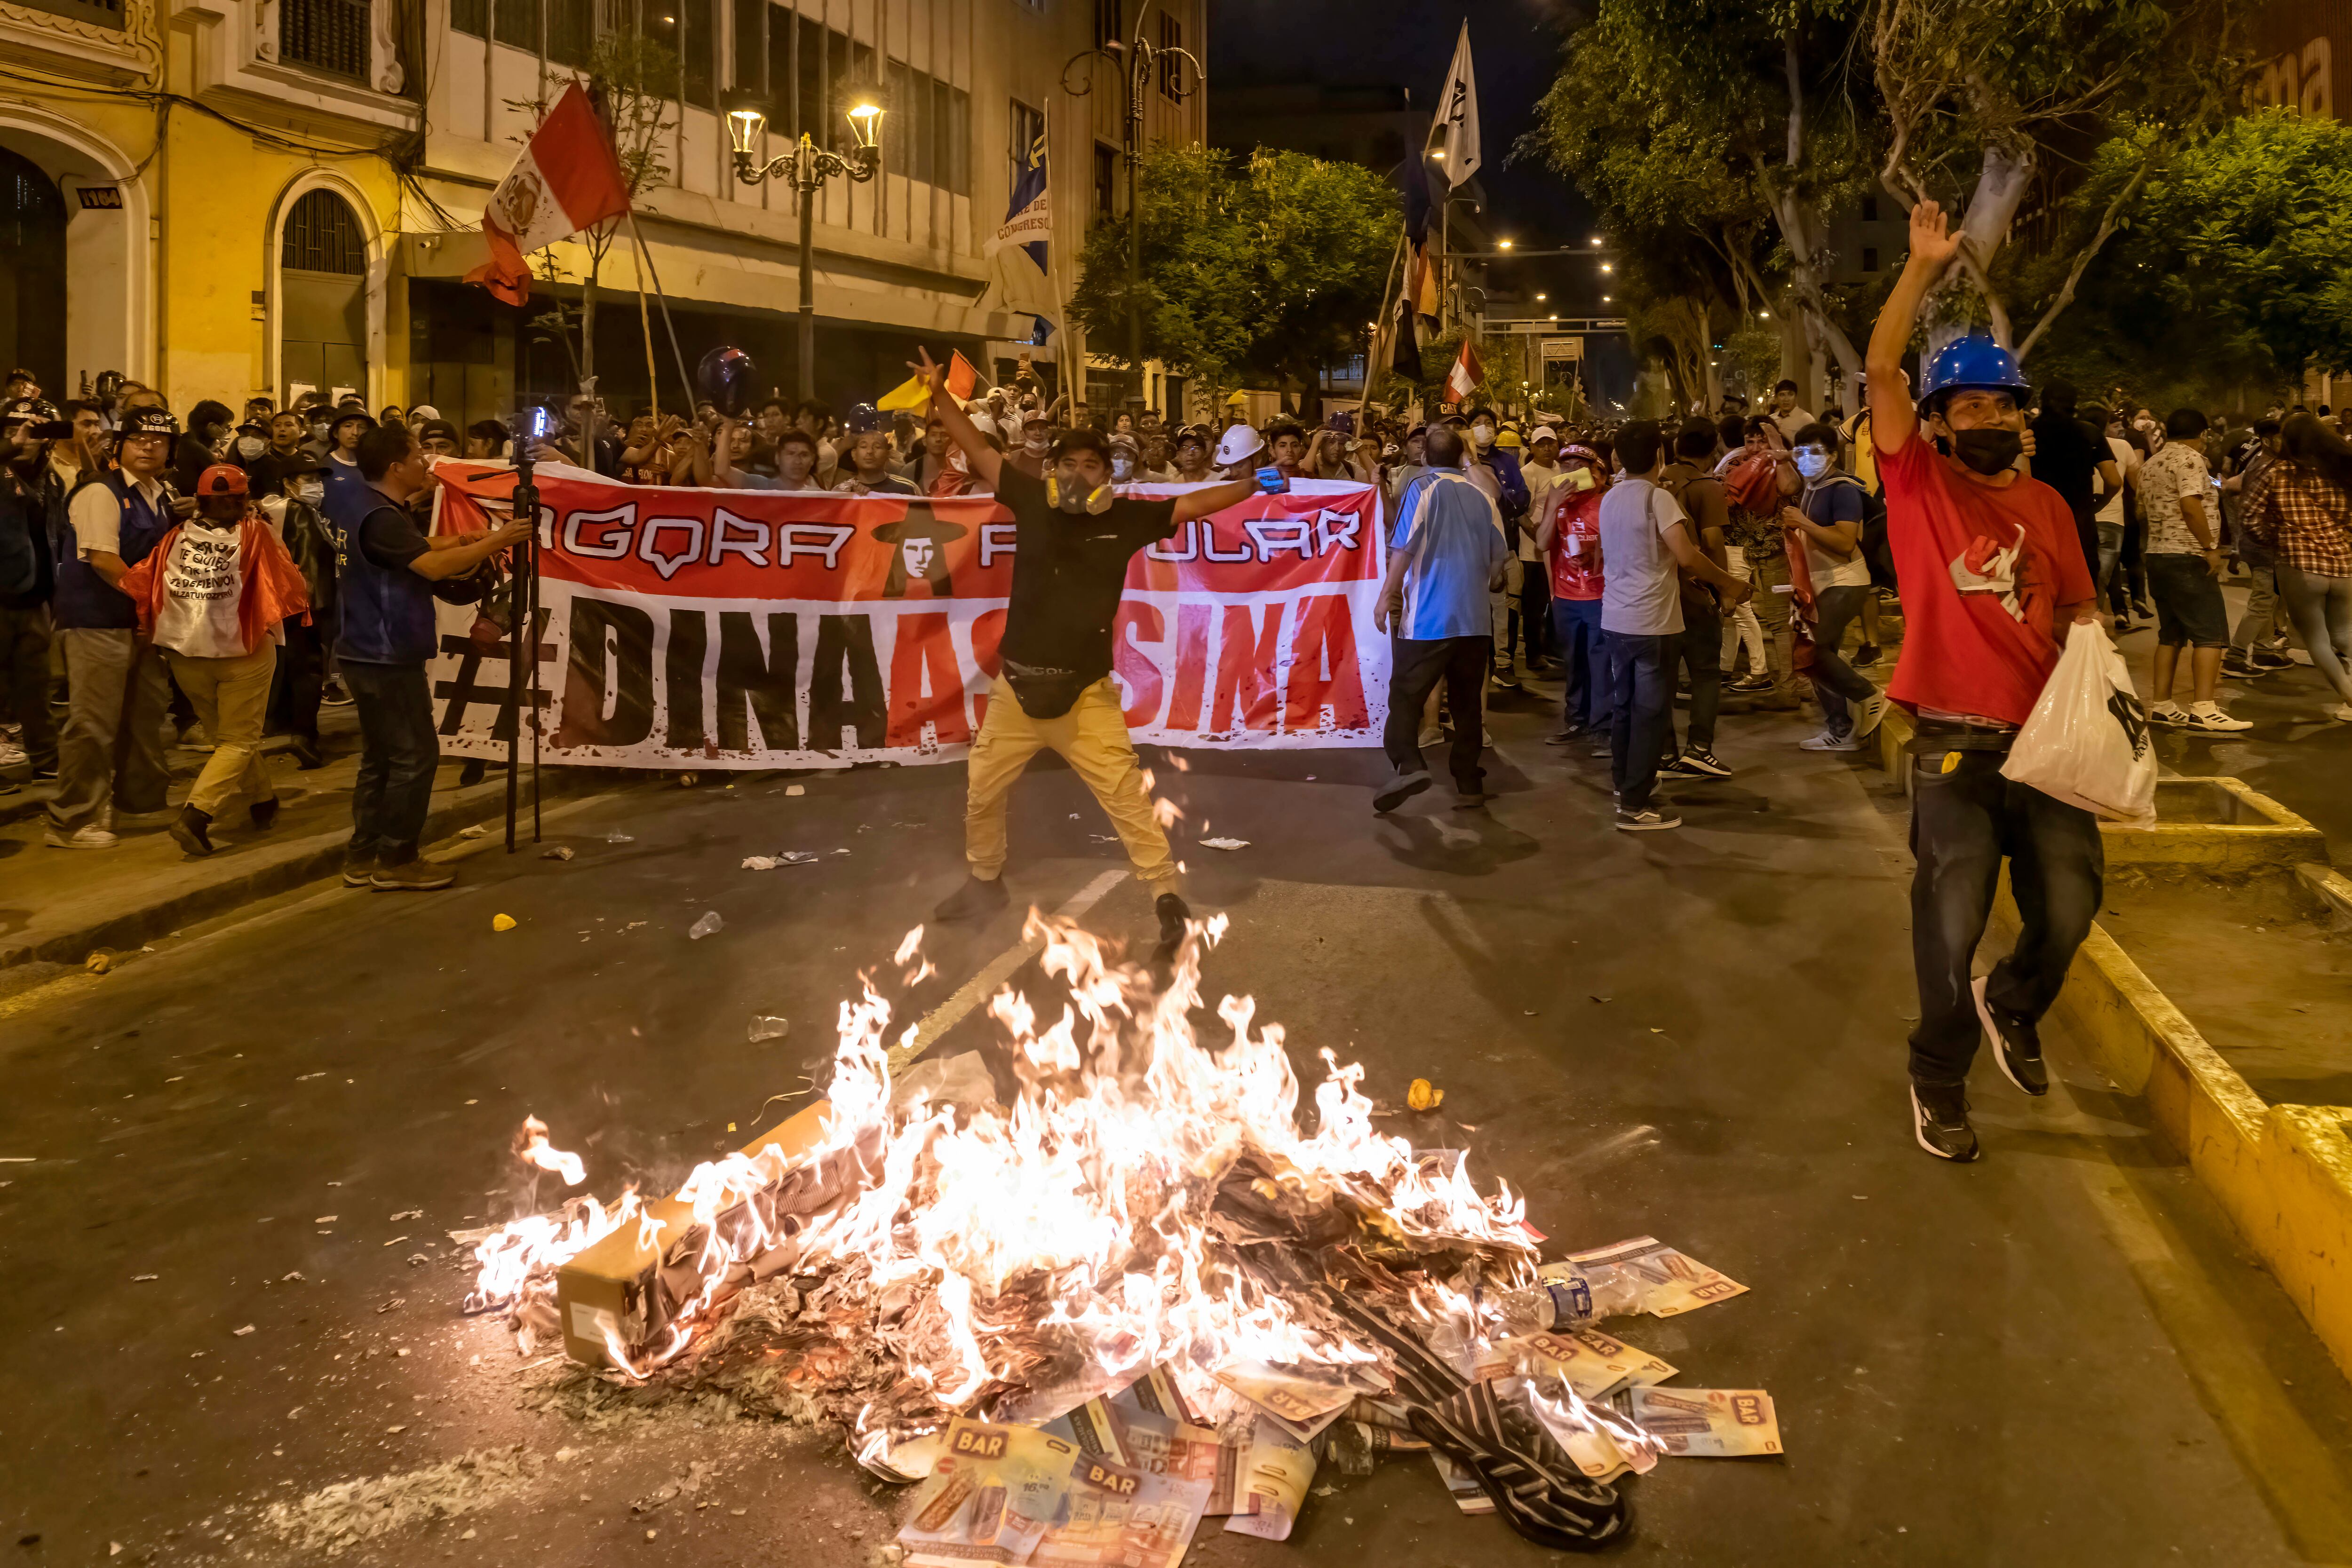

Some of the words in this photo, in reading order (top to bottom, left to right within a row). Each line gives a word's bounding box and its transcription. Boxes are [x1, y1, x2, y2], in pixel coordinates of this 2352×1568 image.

[1034, 199, 1047, 211] DE
[978, 508, 1361, 568] PULAR
[1692, 1283, 1733, 1298] BAR
[1534, 1337, 1572, 1360] BAR
[1580, 1334, 1617, 1355] BAR
[1271, 1390, 1312, 1416] BAR
[1737, 1399, 1761, 1424] BAR
[957, 1431, 1003, 1457] BAR
[1089, 1465, 1136, 1495] BAR
